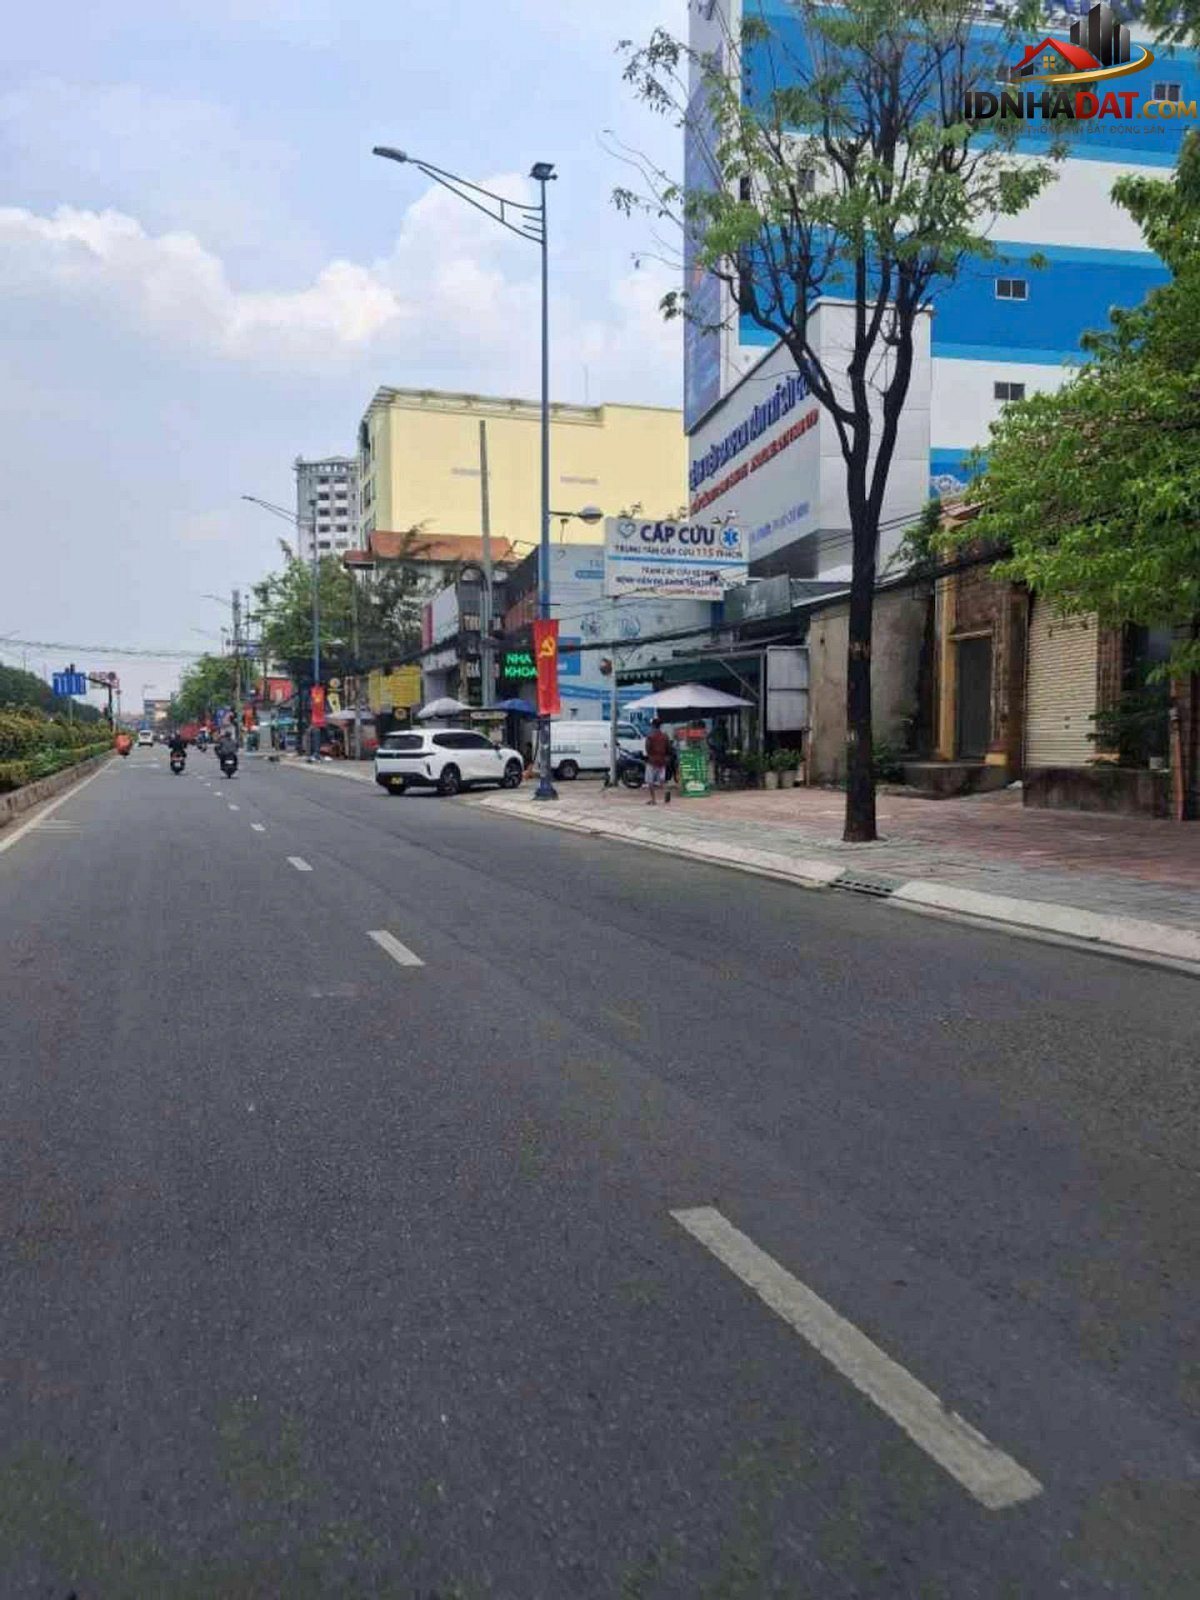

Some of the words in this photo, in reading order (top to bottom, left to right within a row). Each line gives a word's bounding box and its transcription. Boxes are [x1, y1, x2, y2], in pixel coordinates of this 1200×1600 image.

[640, 522, 676, 543] CẤP
[678, 524, 715, 546] CỨU
[504, 666, 538, 679] KHOA
